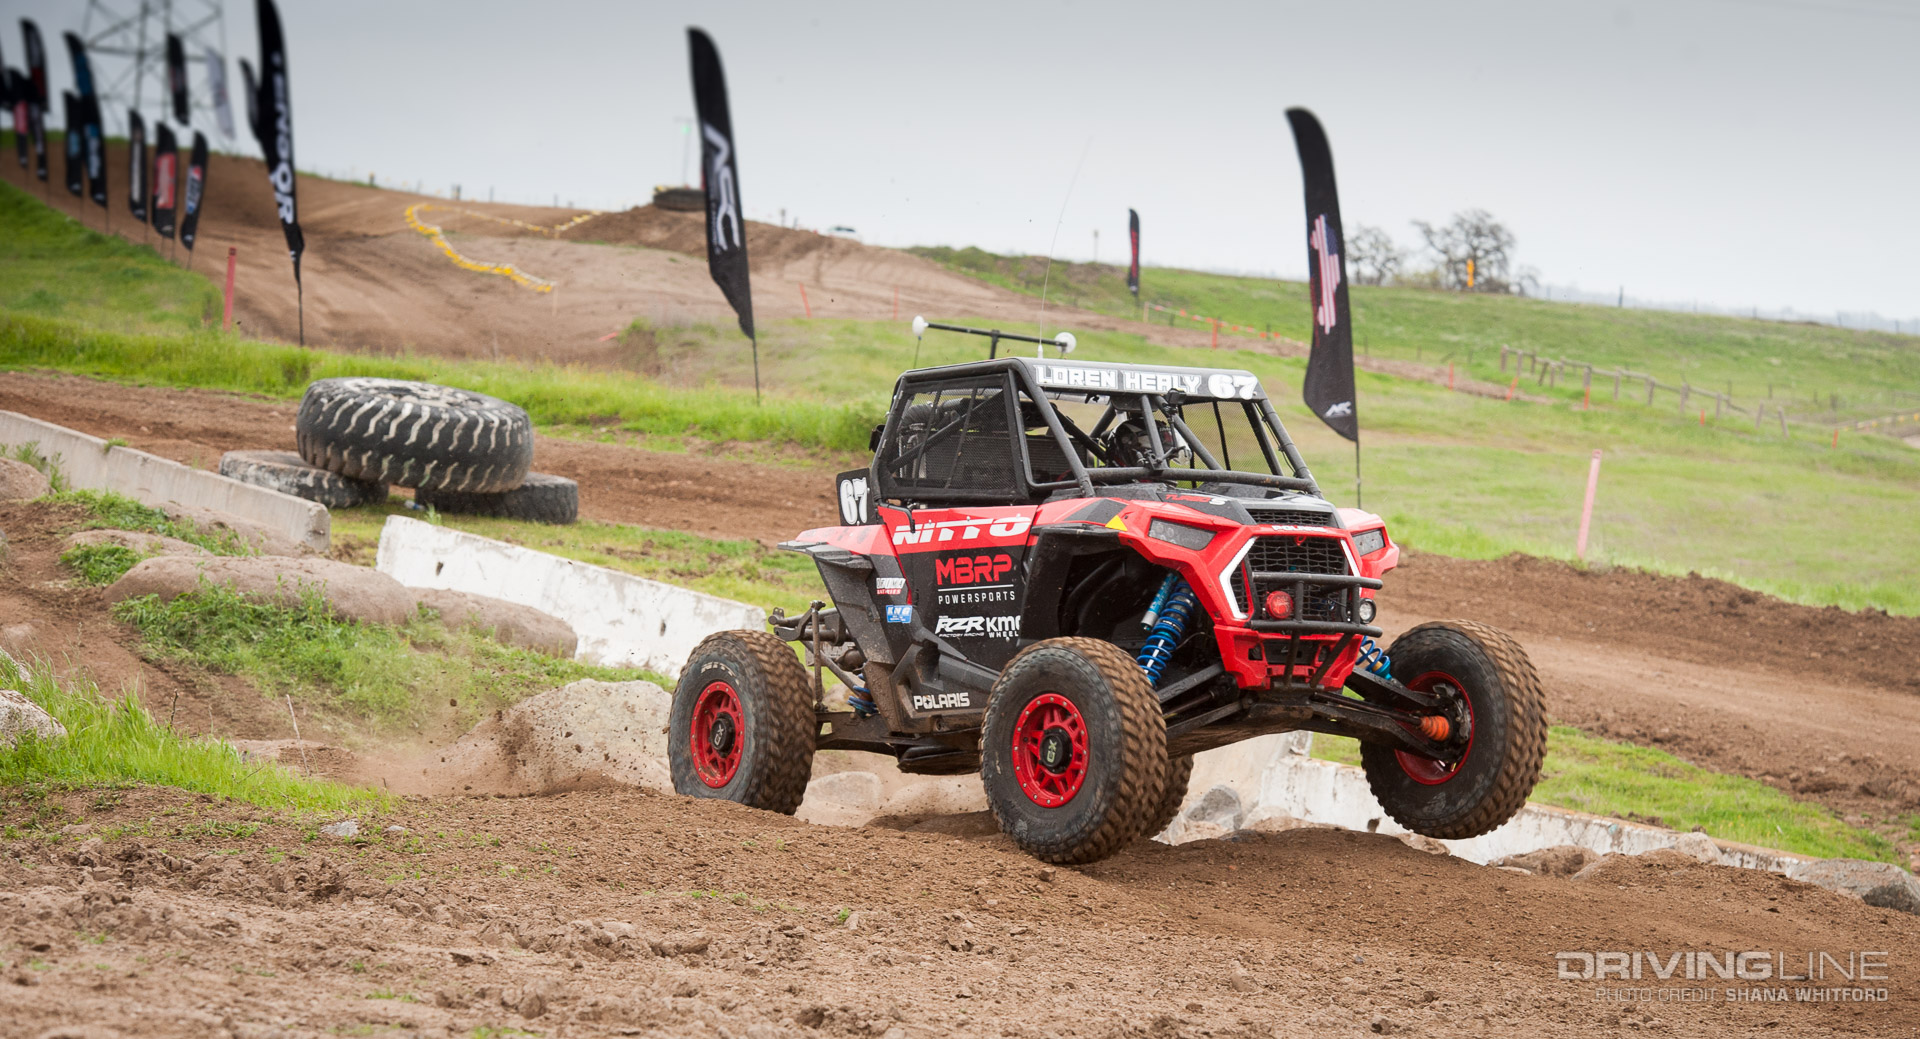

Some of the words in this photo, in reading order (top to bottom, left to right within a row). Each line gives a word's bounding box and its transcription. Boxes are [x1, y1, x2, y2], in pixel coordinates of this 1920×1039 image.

[1033, 365, 1118, 389] LOREN
[1120, 370, 1201, 394] HEALY
[1208, 374, 1259, 400] 67
[840, 477, 868, 525] 67
[892, 516, 1032, 545] NITTO
[935, 554, 1013, 585] MBRP
[938, 590, 1016, 605] POWERSPORTS
[935, 616, 985, 634] RZR
[913, 692, 970, 709] POLARIS
